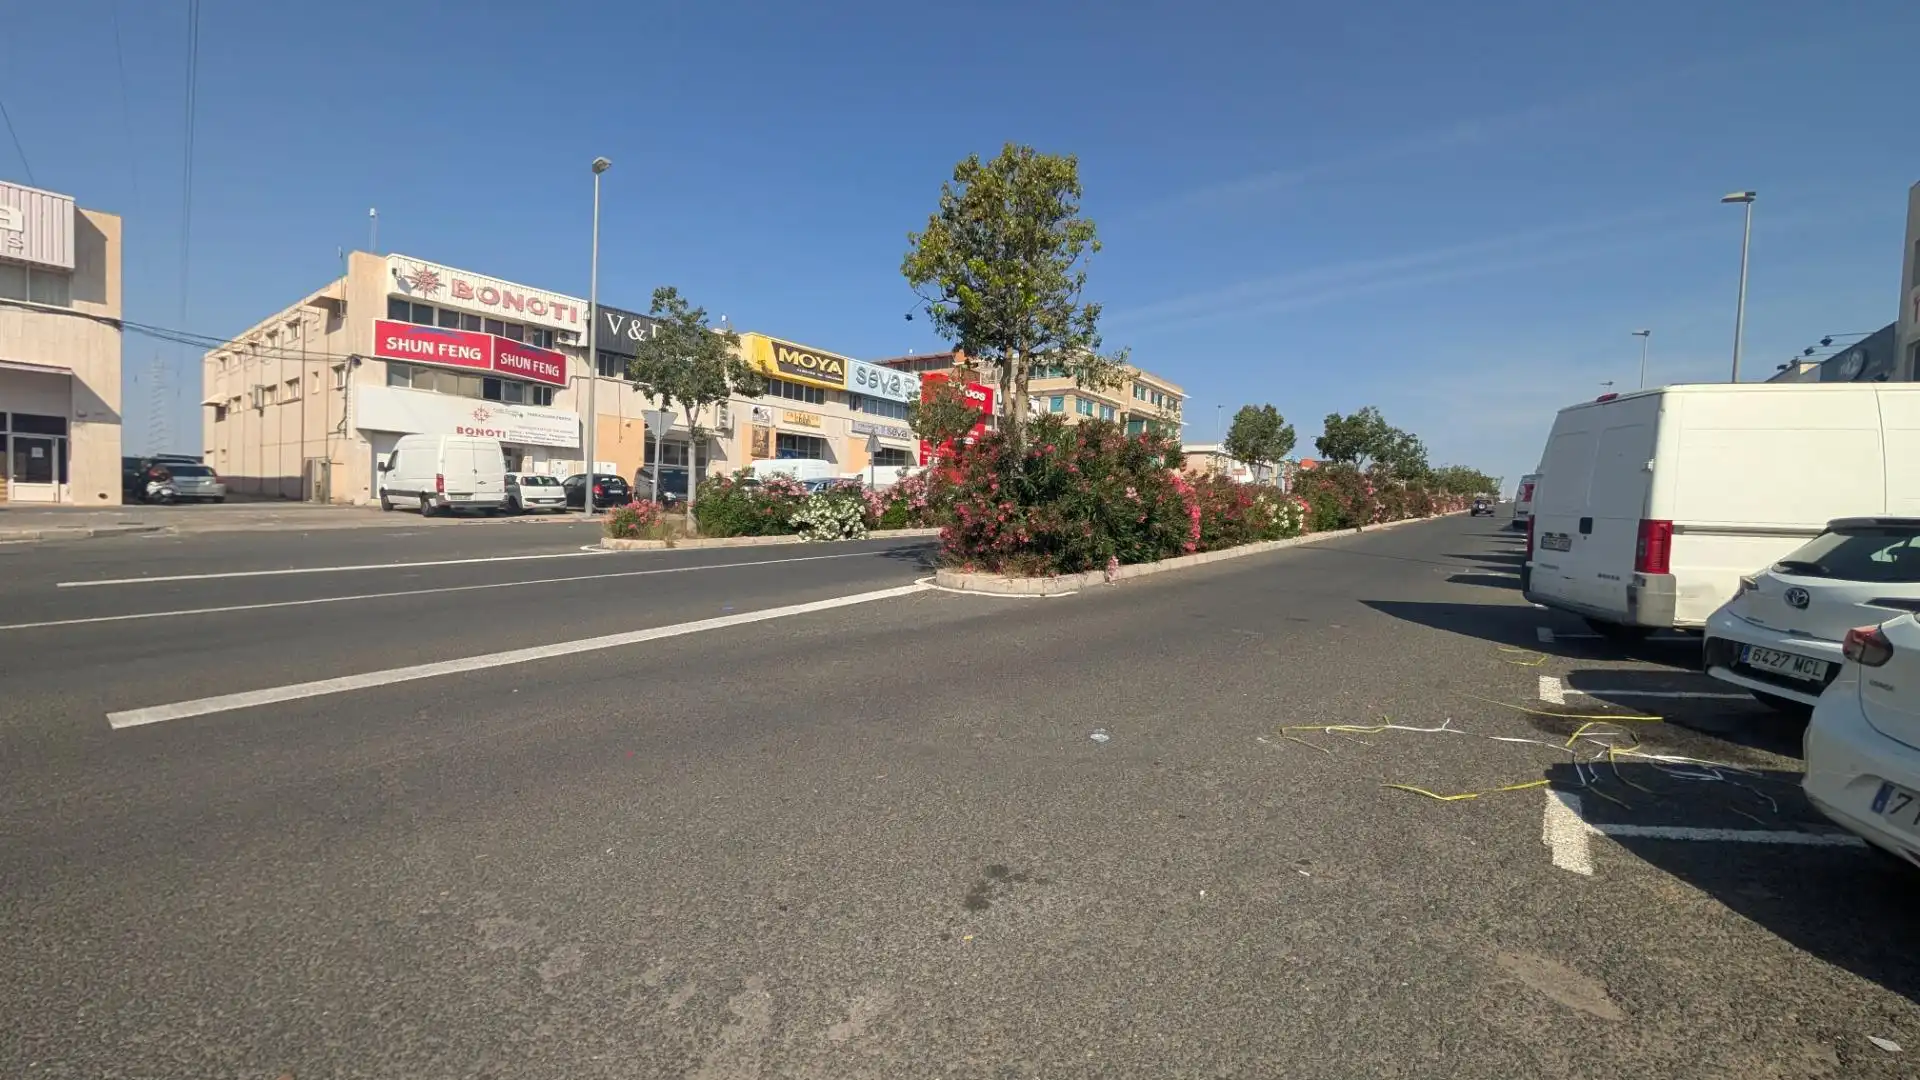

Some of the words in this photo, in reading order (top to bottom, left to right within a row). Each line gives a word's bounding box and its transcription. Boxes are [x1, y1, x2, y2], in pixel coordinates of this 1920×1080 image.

[452, 279, 577, 323] BONOTI
[604, 312, 625, 336] V
[628, 319, 647, 342] &
[386, 336, 435, 355] SHUN
[438, 343, 482, 361] FENG
[778, 347, 843, 375] MOYA
[500, 352, 531, 371] SHUN
[532, 361, 560, 378] FENG
[456, 426, 506, 438] BONOTI
[1751, 648, 1790, 669] 6427
[1792, 657, 1821, 677] MCL
